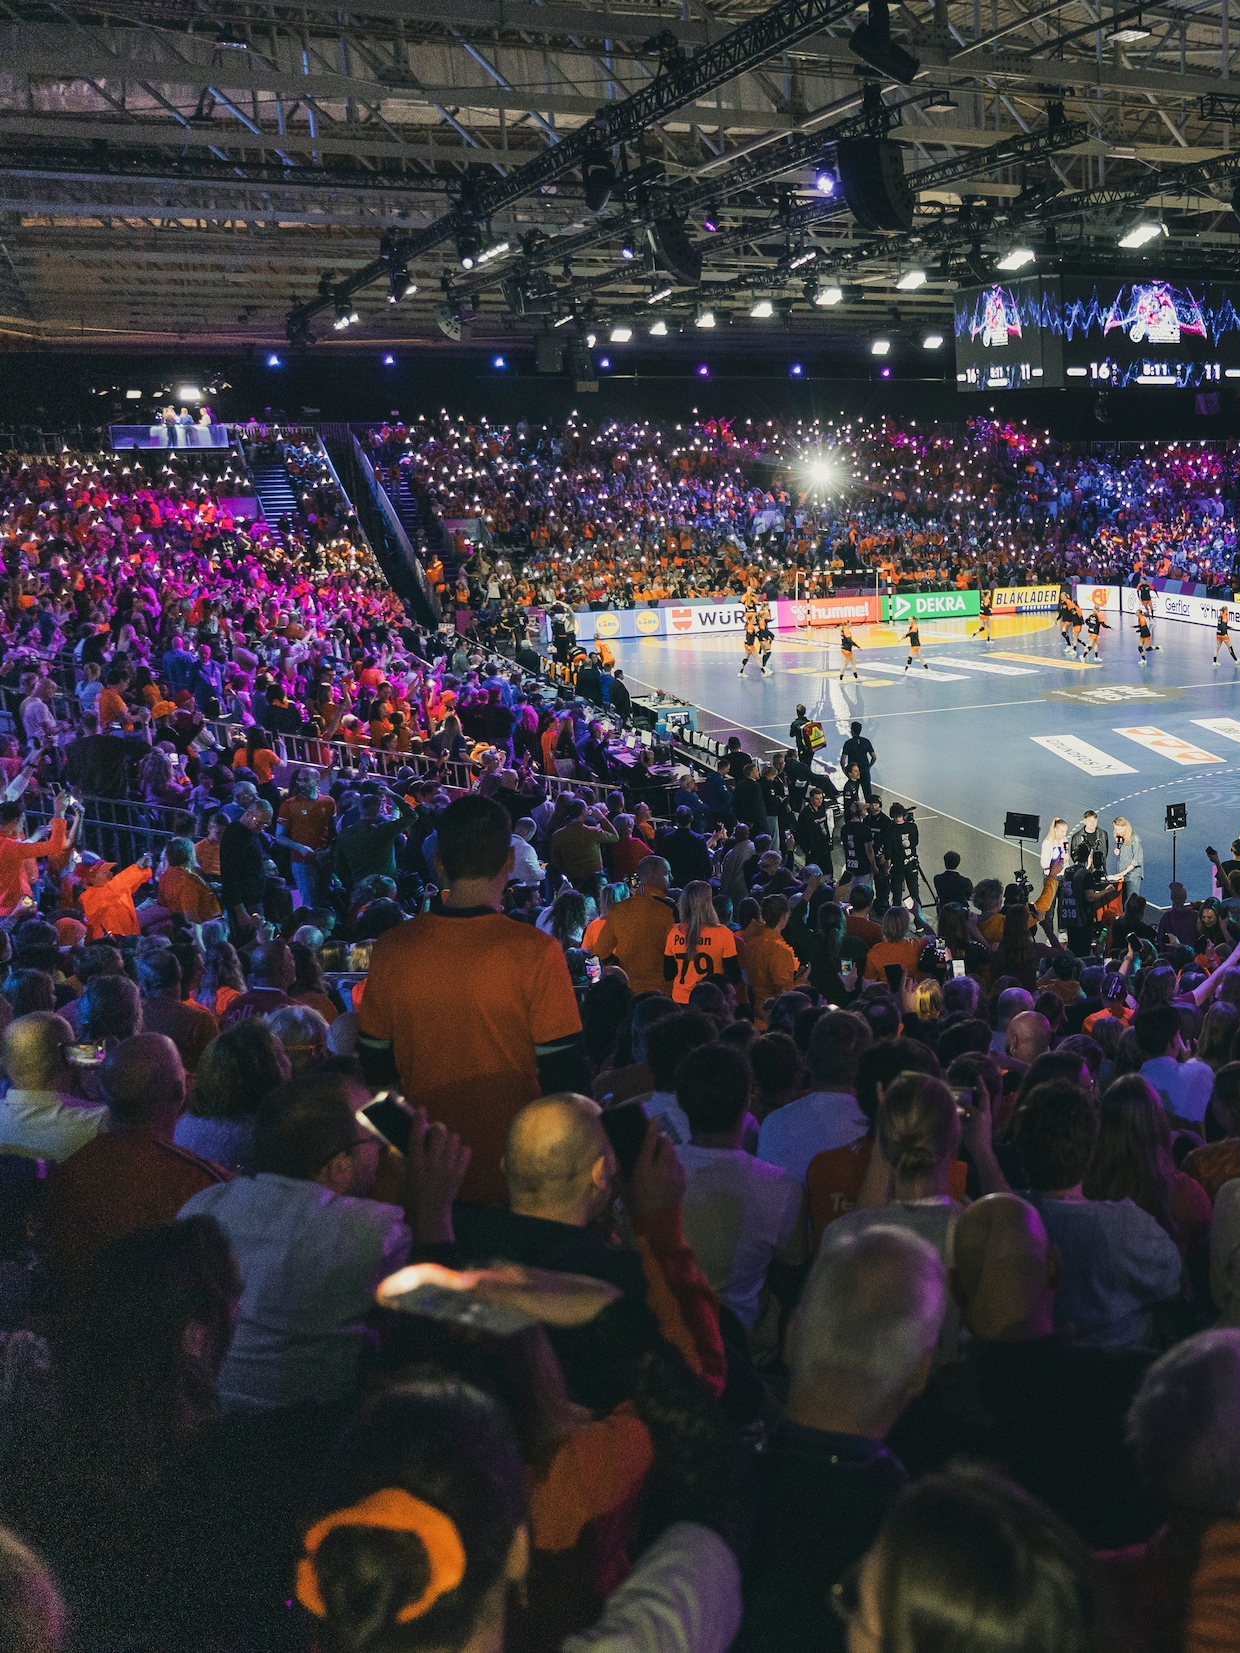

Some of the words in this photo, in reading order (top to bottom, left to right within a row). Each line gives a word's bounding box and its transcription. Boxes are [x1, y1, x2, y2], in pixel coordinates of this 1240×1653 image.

[966, 369, 977, 383] 16
[1090, 362, 1110, 379] 16
[1205, 364, 1221, 380] 11
[916, 596, 967, 613] DEKRA
[996, 588, 1057, 606] BLÅKLÄDER
[1165, 597, 1190, 615] Gerflor
[812, 601, 869, 620] hummel
[1062, 908, 1077, 919] 350
[675, 952, 715, 985] 79
